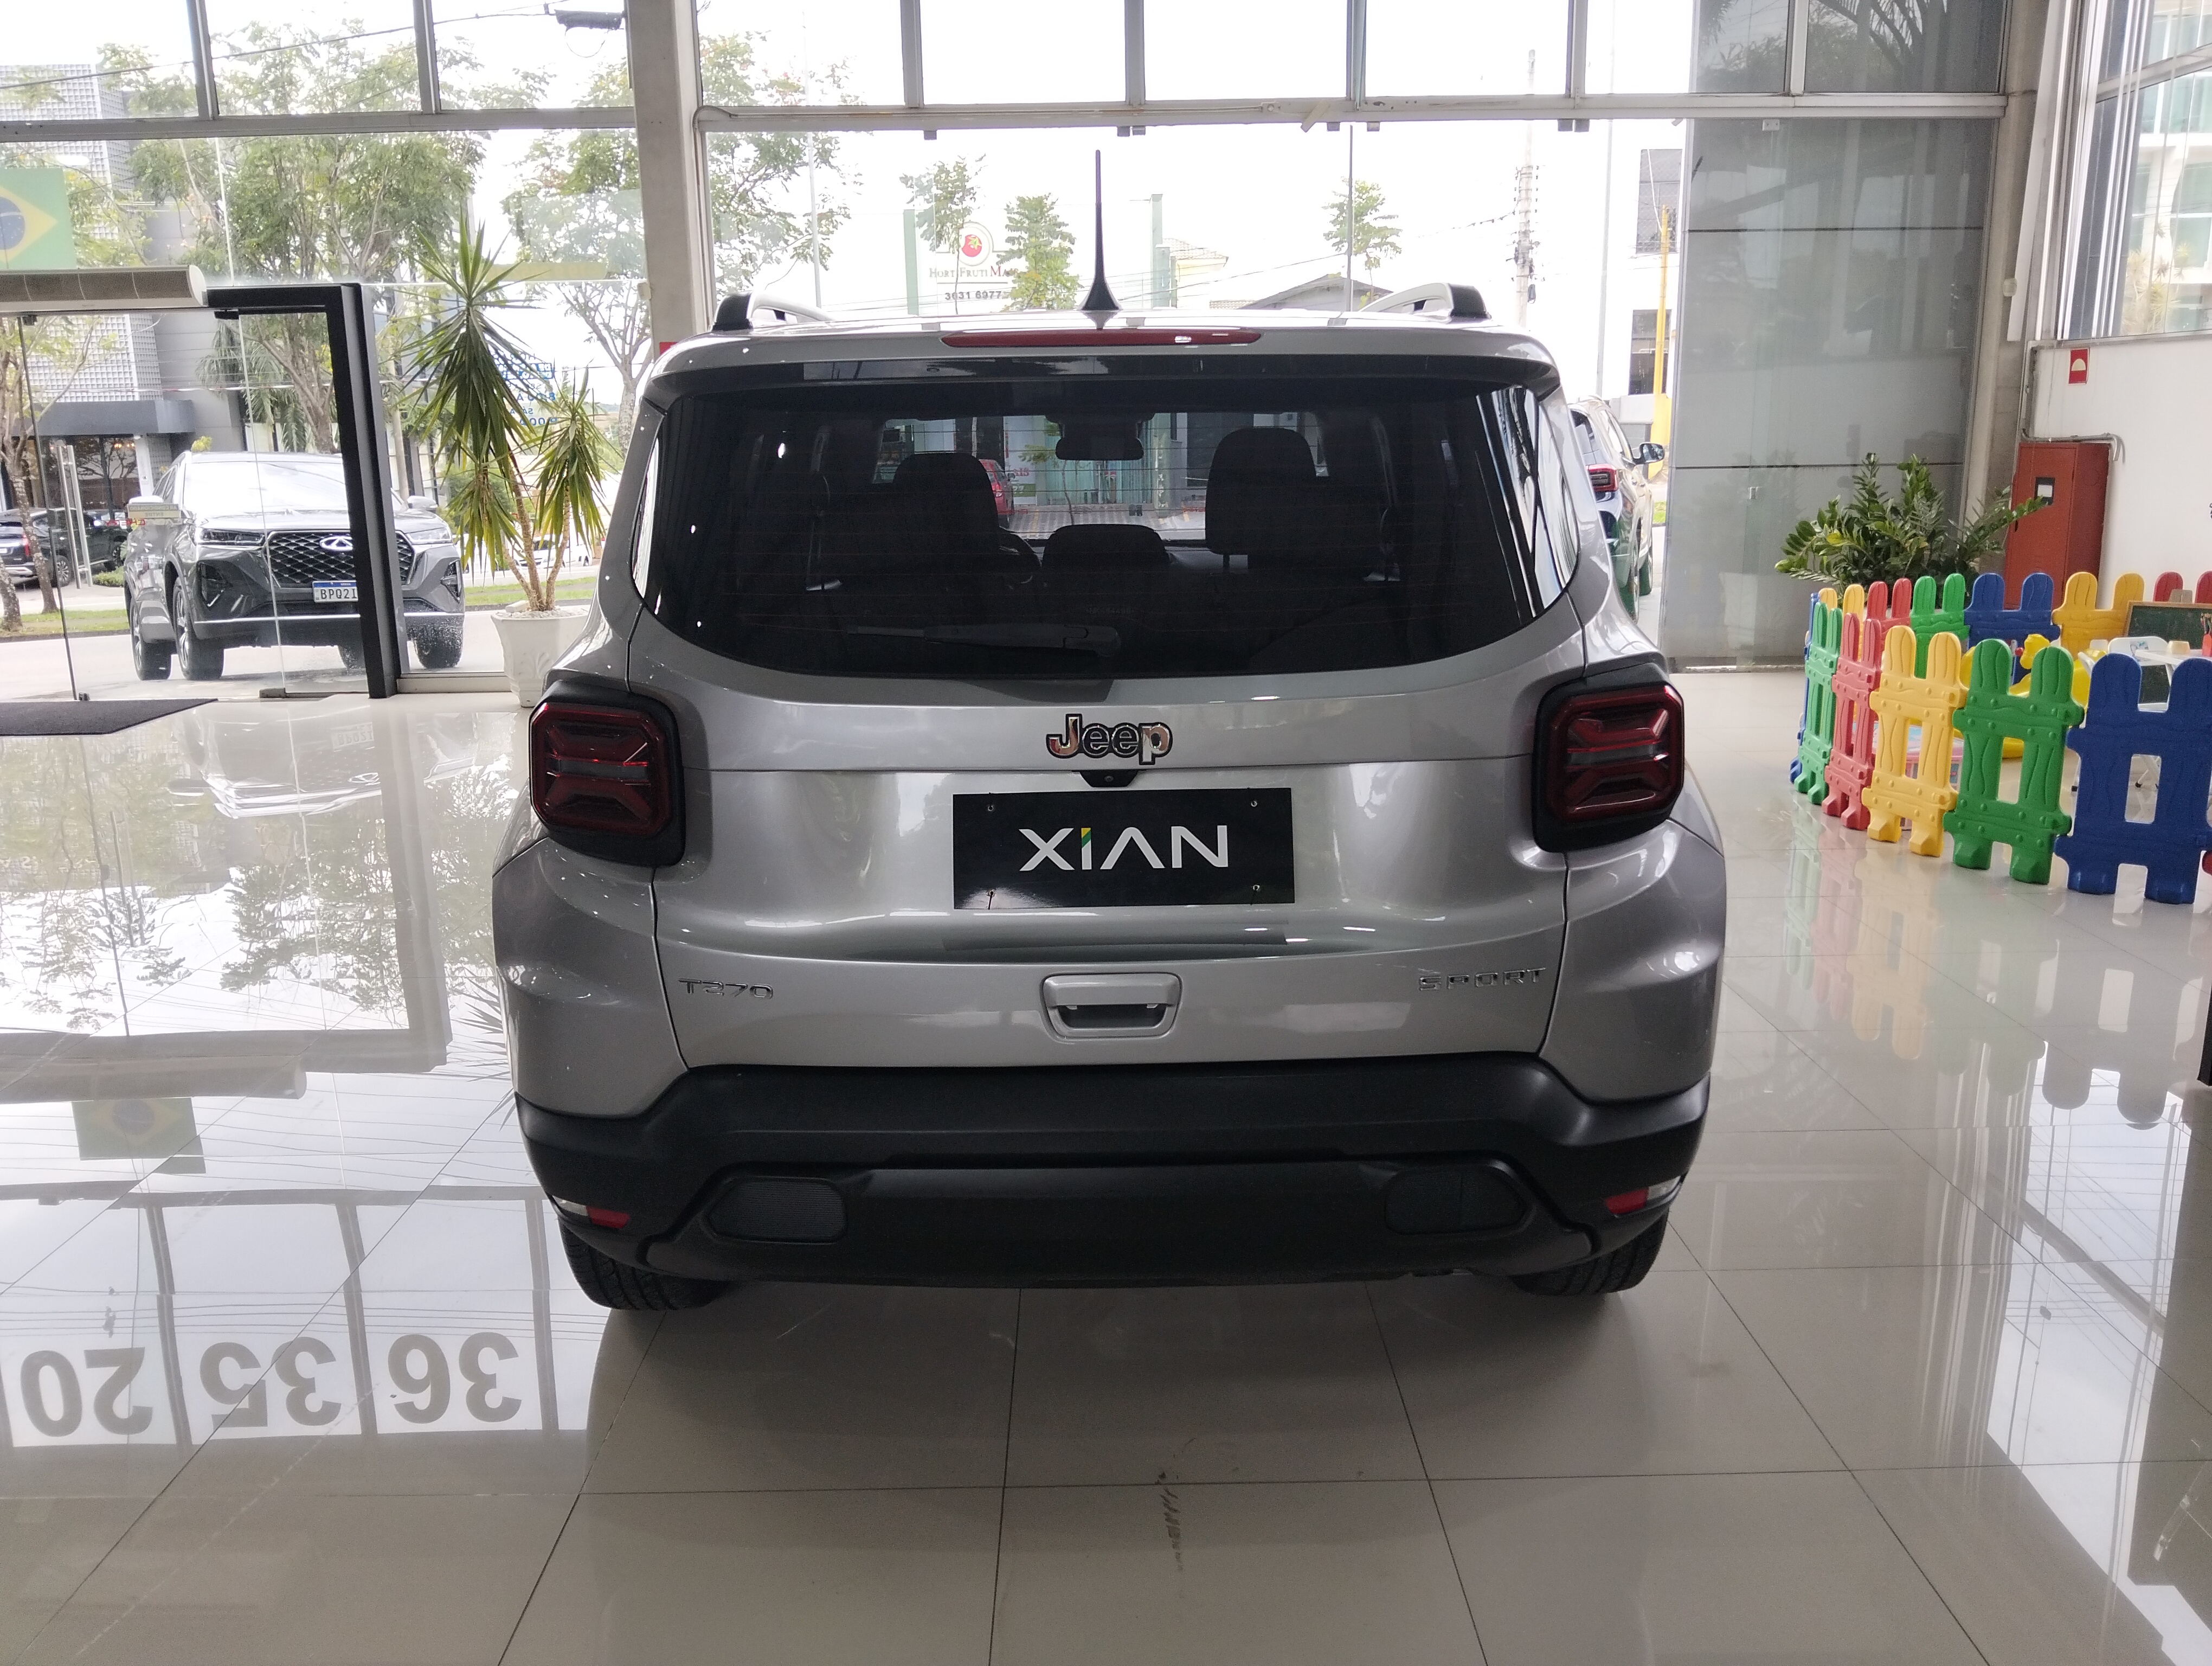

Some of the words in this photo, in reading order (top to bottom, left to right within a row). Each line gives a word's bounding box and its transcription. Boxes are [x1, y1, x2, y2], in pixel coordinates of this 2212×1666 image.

[960, 267, 988, 277] FRUTI
[1046, 714, 1173, 765] Jeep
[1019, 825, 1229, 872] XIAN
[678, 978, 774, 999] T270
[1418, 967, 1546, 991] SPORT
